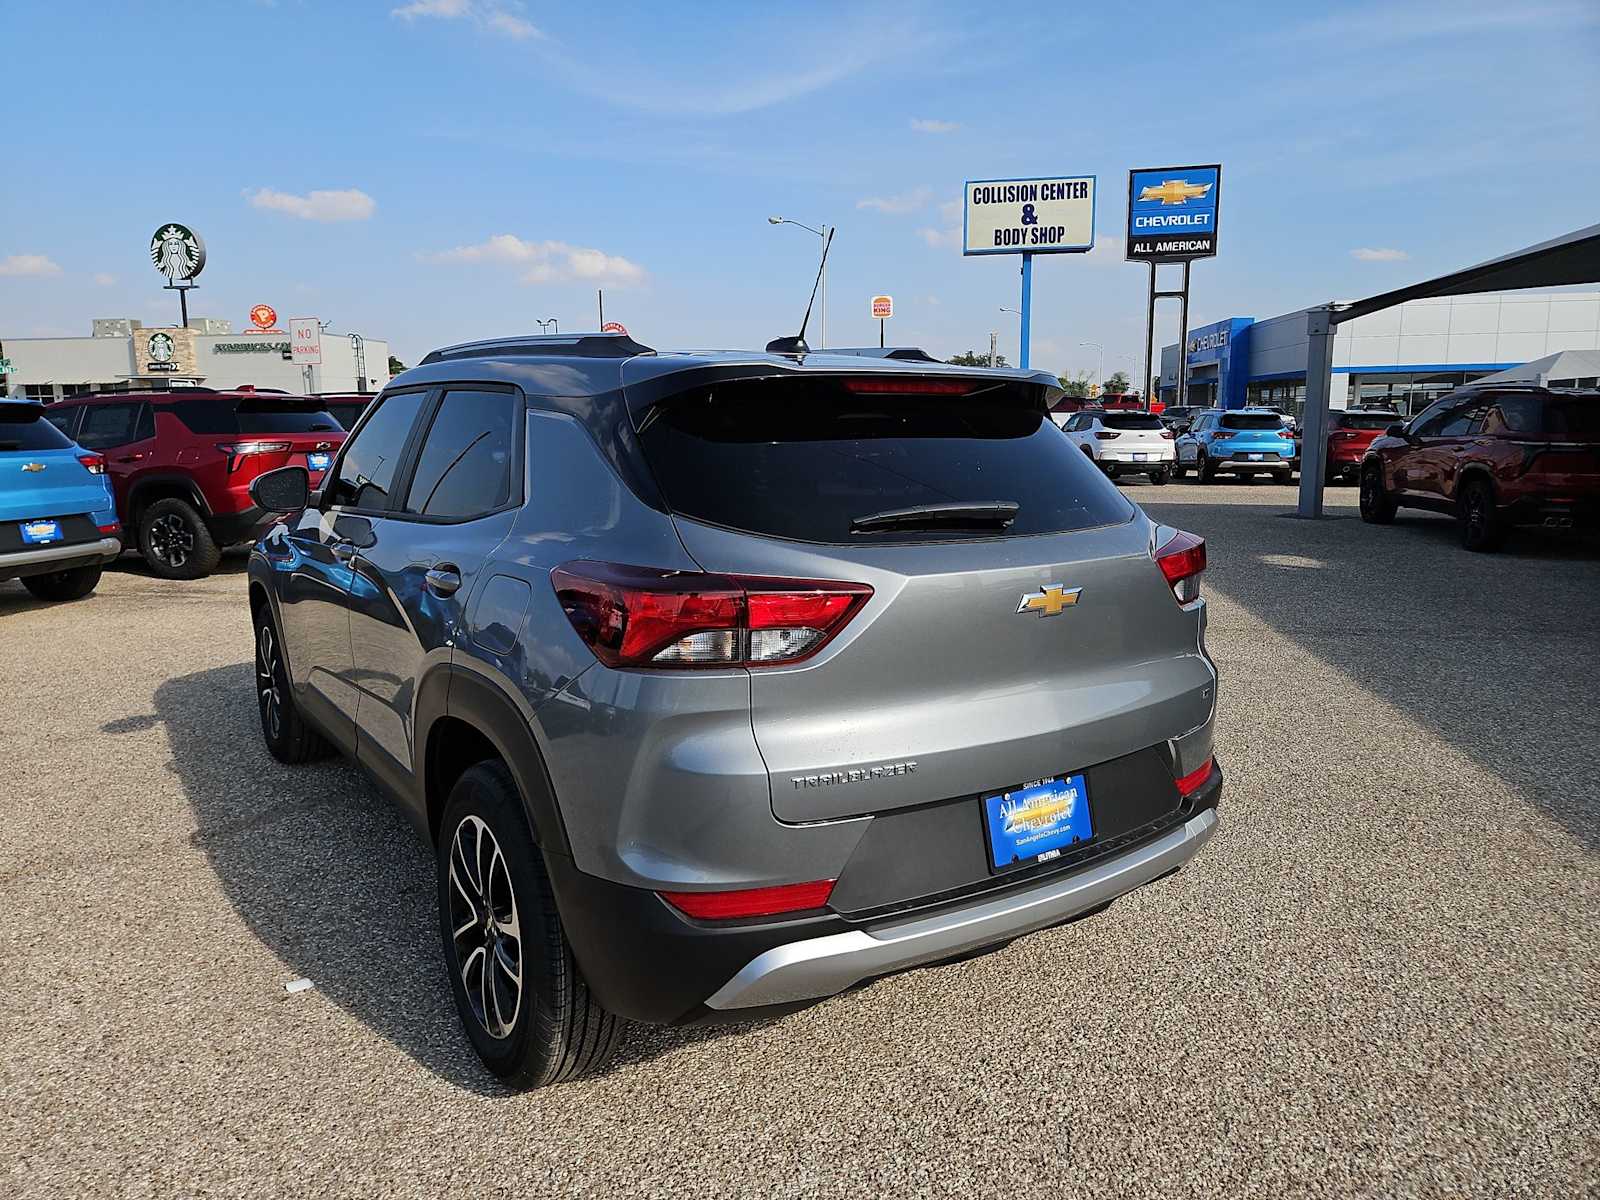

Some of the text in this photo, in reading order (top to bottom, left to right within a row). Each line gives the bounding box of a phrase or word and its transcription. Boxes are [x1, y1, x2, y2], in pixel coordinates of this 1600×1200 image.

[973, 181, 1088, 205] COLLISION CENTER
[1020, 203, 1038, 226] &
[1135, 213, 1210, 228] CHEVROLET
[994, 226, 1065, 246] BODY SHOP
[1134, 239, 1211, 253] ALL AMERICAN
[297, 328, 312, 339] NO
[292, 345, 320, 354] PARKING
[791, 761, 918, 789] TRAILBLAZER
[1023, 779, 1042, 790] SINCE
[999, 787, 1078, 819] All American
